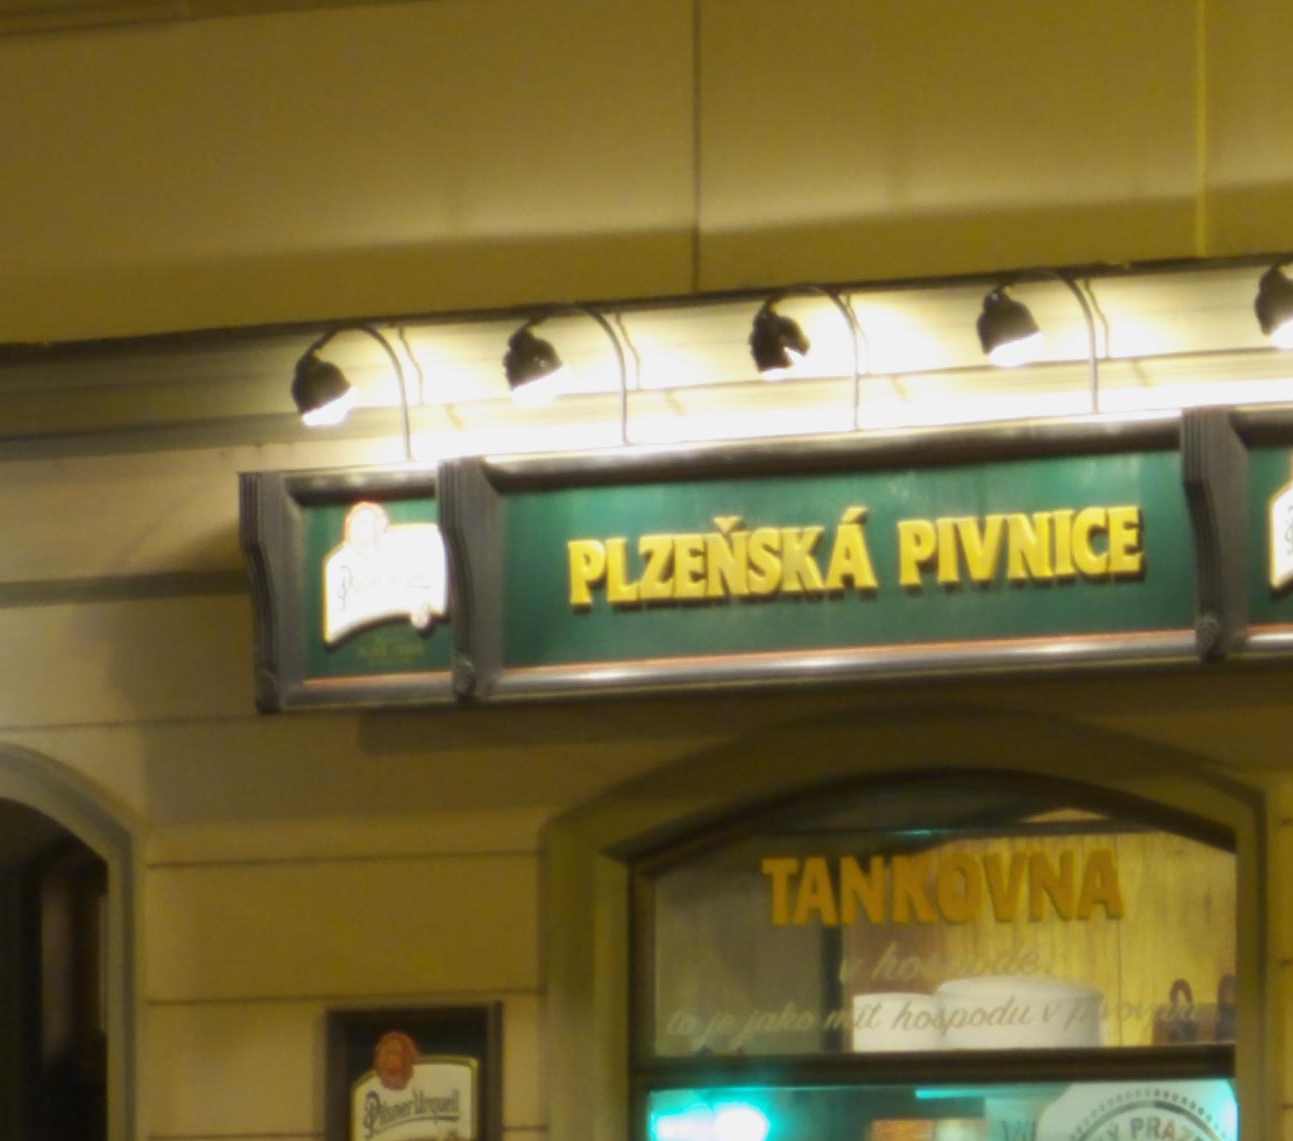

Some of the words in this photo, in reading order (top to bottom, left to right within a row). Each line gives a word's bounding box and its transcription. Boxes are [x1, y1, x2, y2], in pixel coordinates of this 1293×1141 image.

[567, 505, 879, 608] PLZEŇSKÁ
[896, 505, 1148, 589] PIVNICE
[760, 844, 1125, 927] TANKOVNA
[890, 997, 1030, 1036] hospodu
[363, 1090, 413, 1140] Pilsner
[412, 1088, 460, 1125] Urquell
